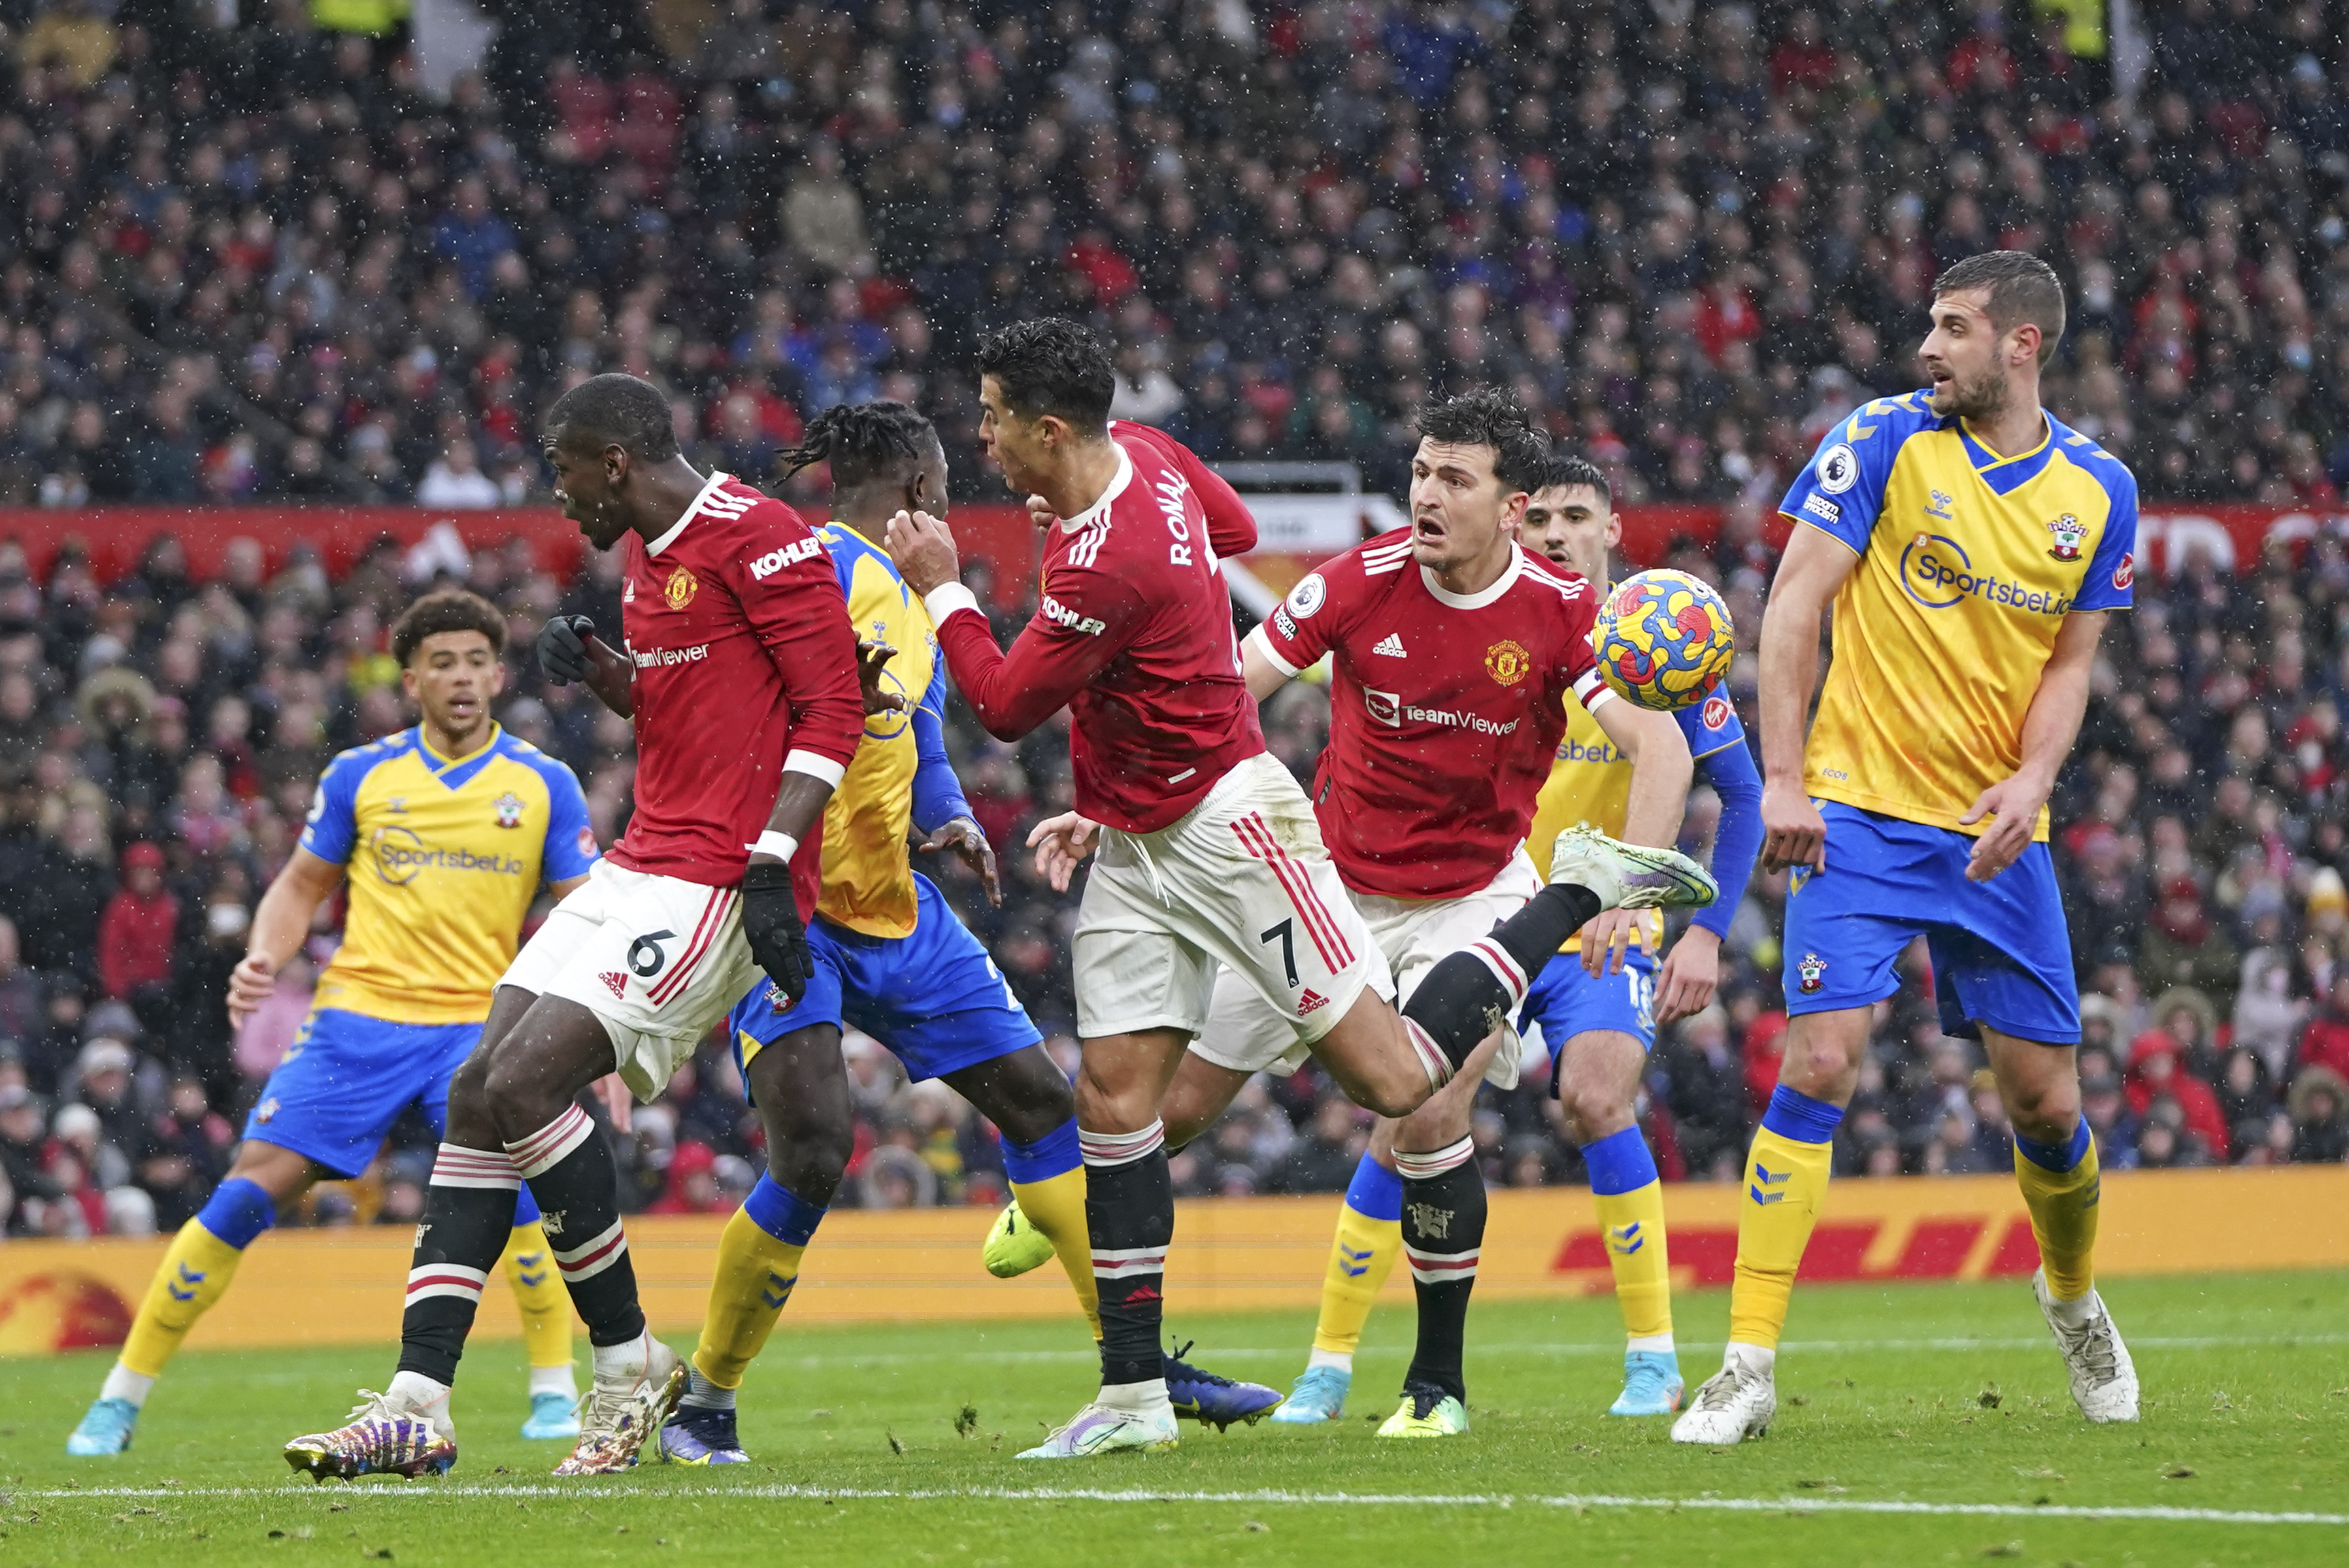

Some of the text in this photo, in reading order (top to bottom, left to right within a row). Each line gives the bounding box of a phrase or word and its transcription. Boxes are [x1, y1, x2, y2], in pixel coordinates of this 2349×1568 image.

[1156, 469, 1192, 566] RONAL
[749, 537, 822, 580] KOHLER
[1918, 554, 2071, 614] Sportsbet.io
[1042, 593, 1106, 637] KOHLER
[632, 644, 710, 668] TeamViewer
[1373, 646, 1407, 658] adidas
[1493, 672, 1518, 682] UNITED
[1401, 705, 1520, 736] TeamViewer
[380, 844, 524, 875] Sportsbet.io
[627, 928, 678, 978] 6
[1259, 916, 1301, 990] 7
[598, 973, 624, 1000] adidas
[1297, 997, 1330, 1016] adidas
